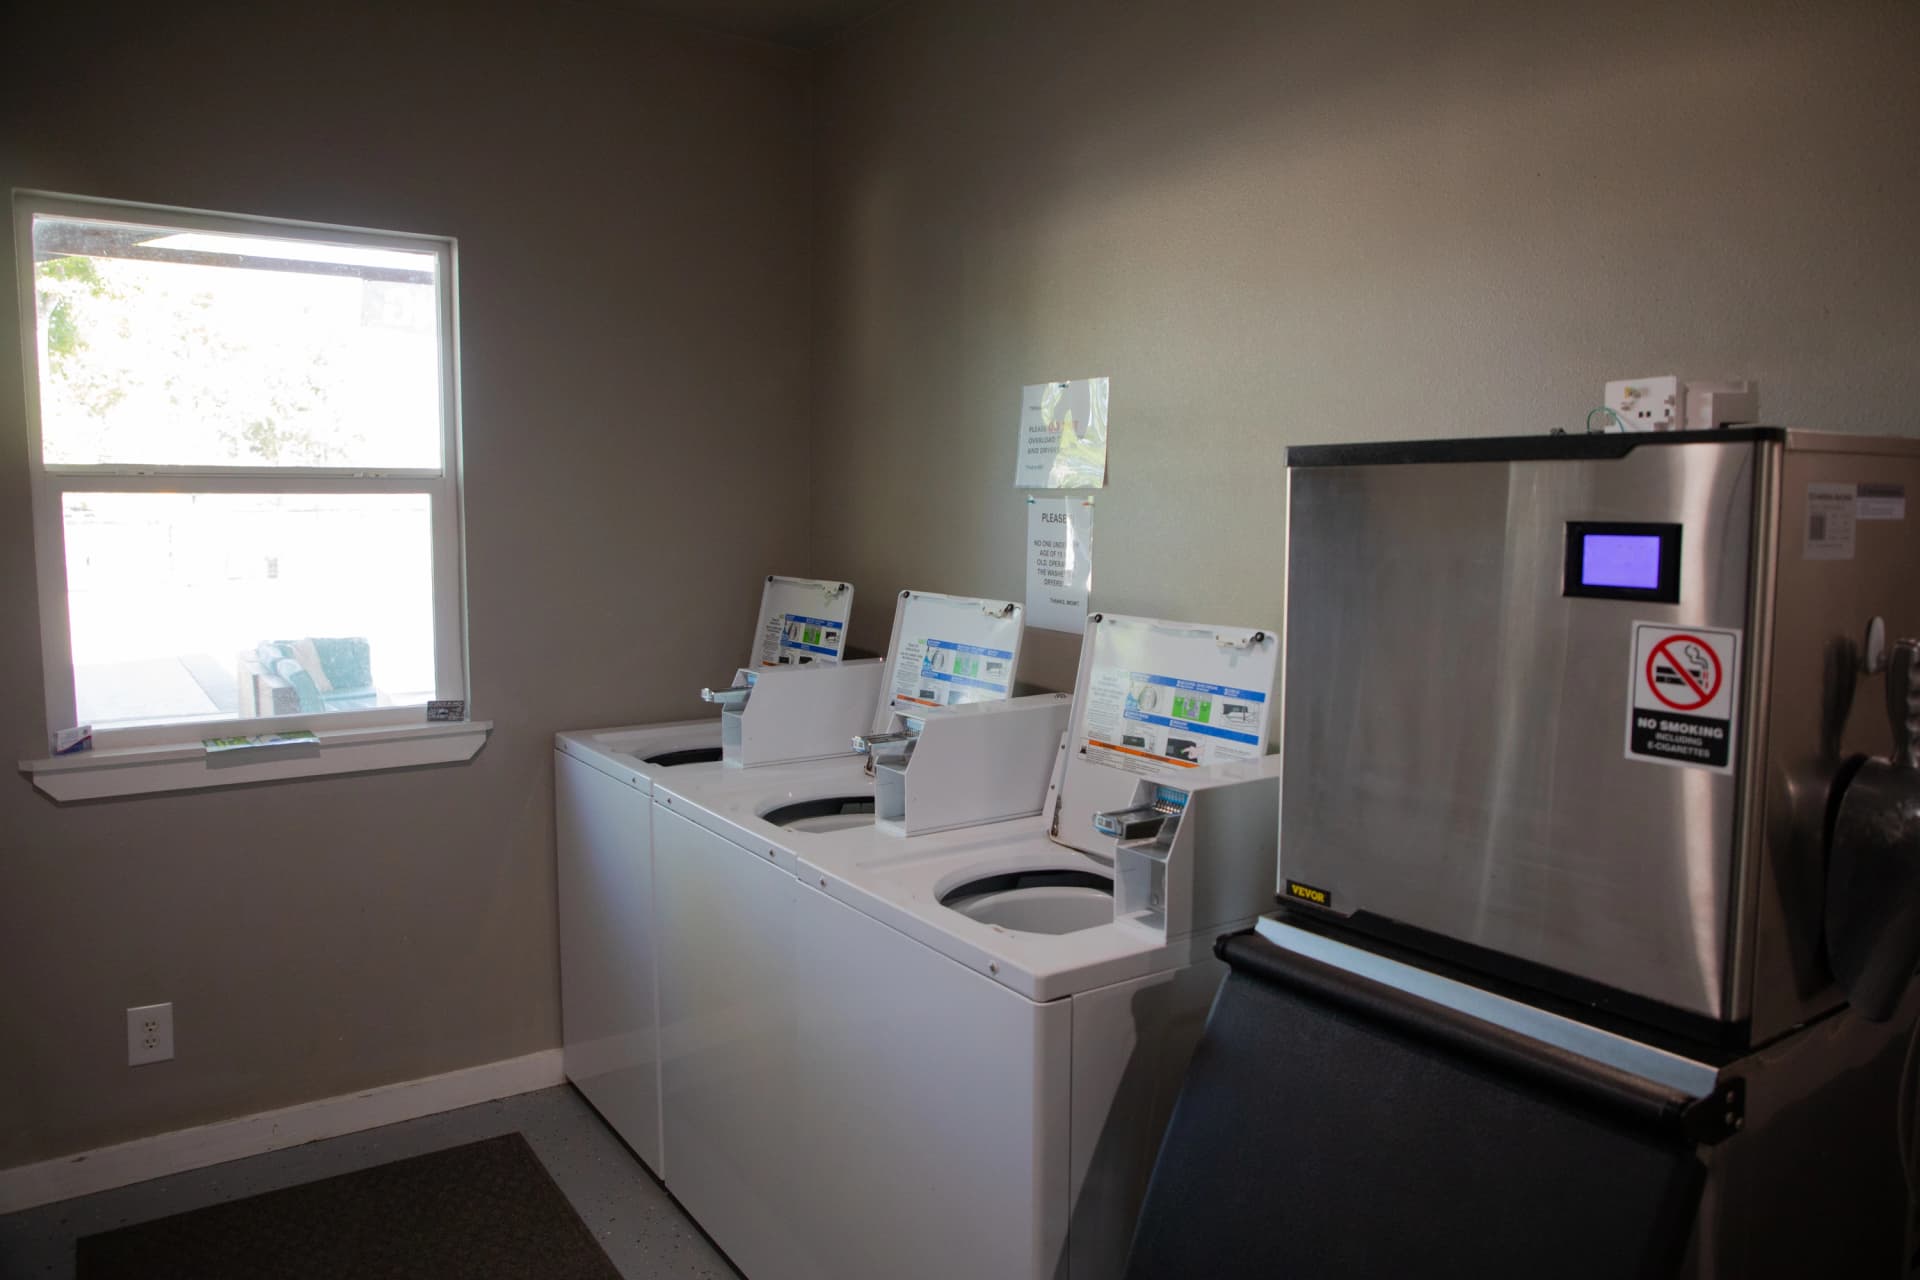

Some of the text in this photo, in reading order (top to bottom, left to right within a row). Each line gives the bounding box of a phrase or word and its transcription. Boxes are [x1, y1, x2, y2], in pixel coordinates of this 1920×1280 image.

[1041, 512, 1067, 524] PLEASE
[1033, 539, 1042, 547] NO
[1039, 549, 1049, 557] AGE
[1037, 568, 1046, 576] THE
[1637, 716, 1724, 739] NO SMOKING
[1654, 732, 1703, 746] INCLUDING
[1646, 740, 1711, 758] E-CIGARETTES
[1291, 884, 1325, 903] VEVOR
